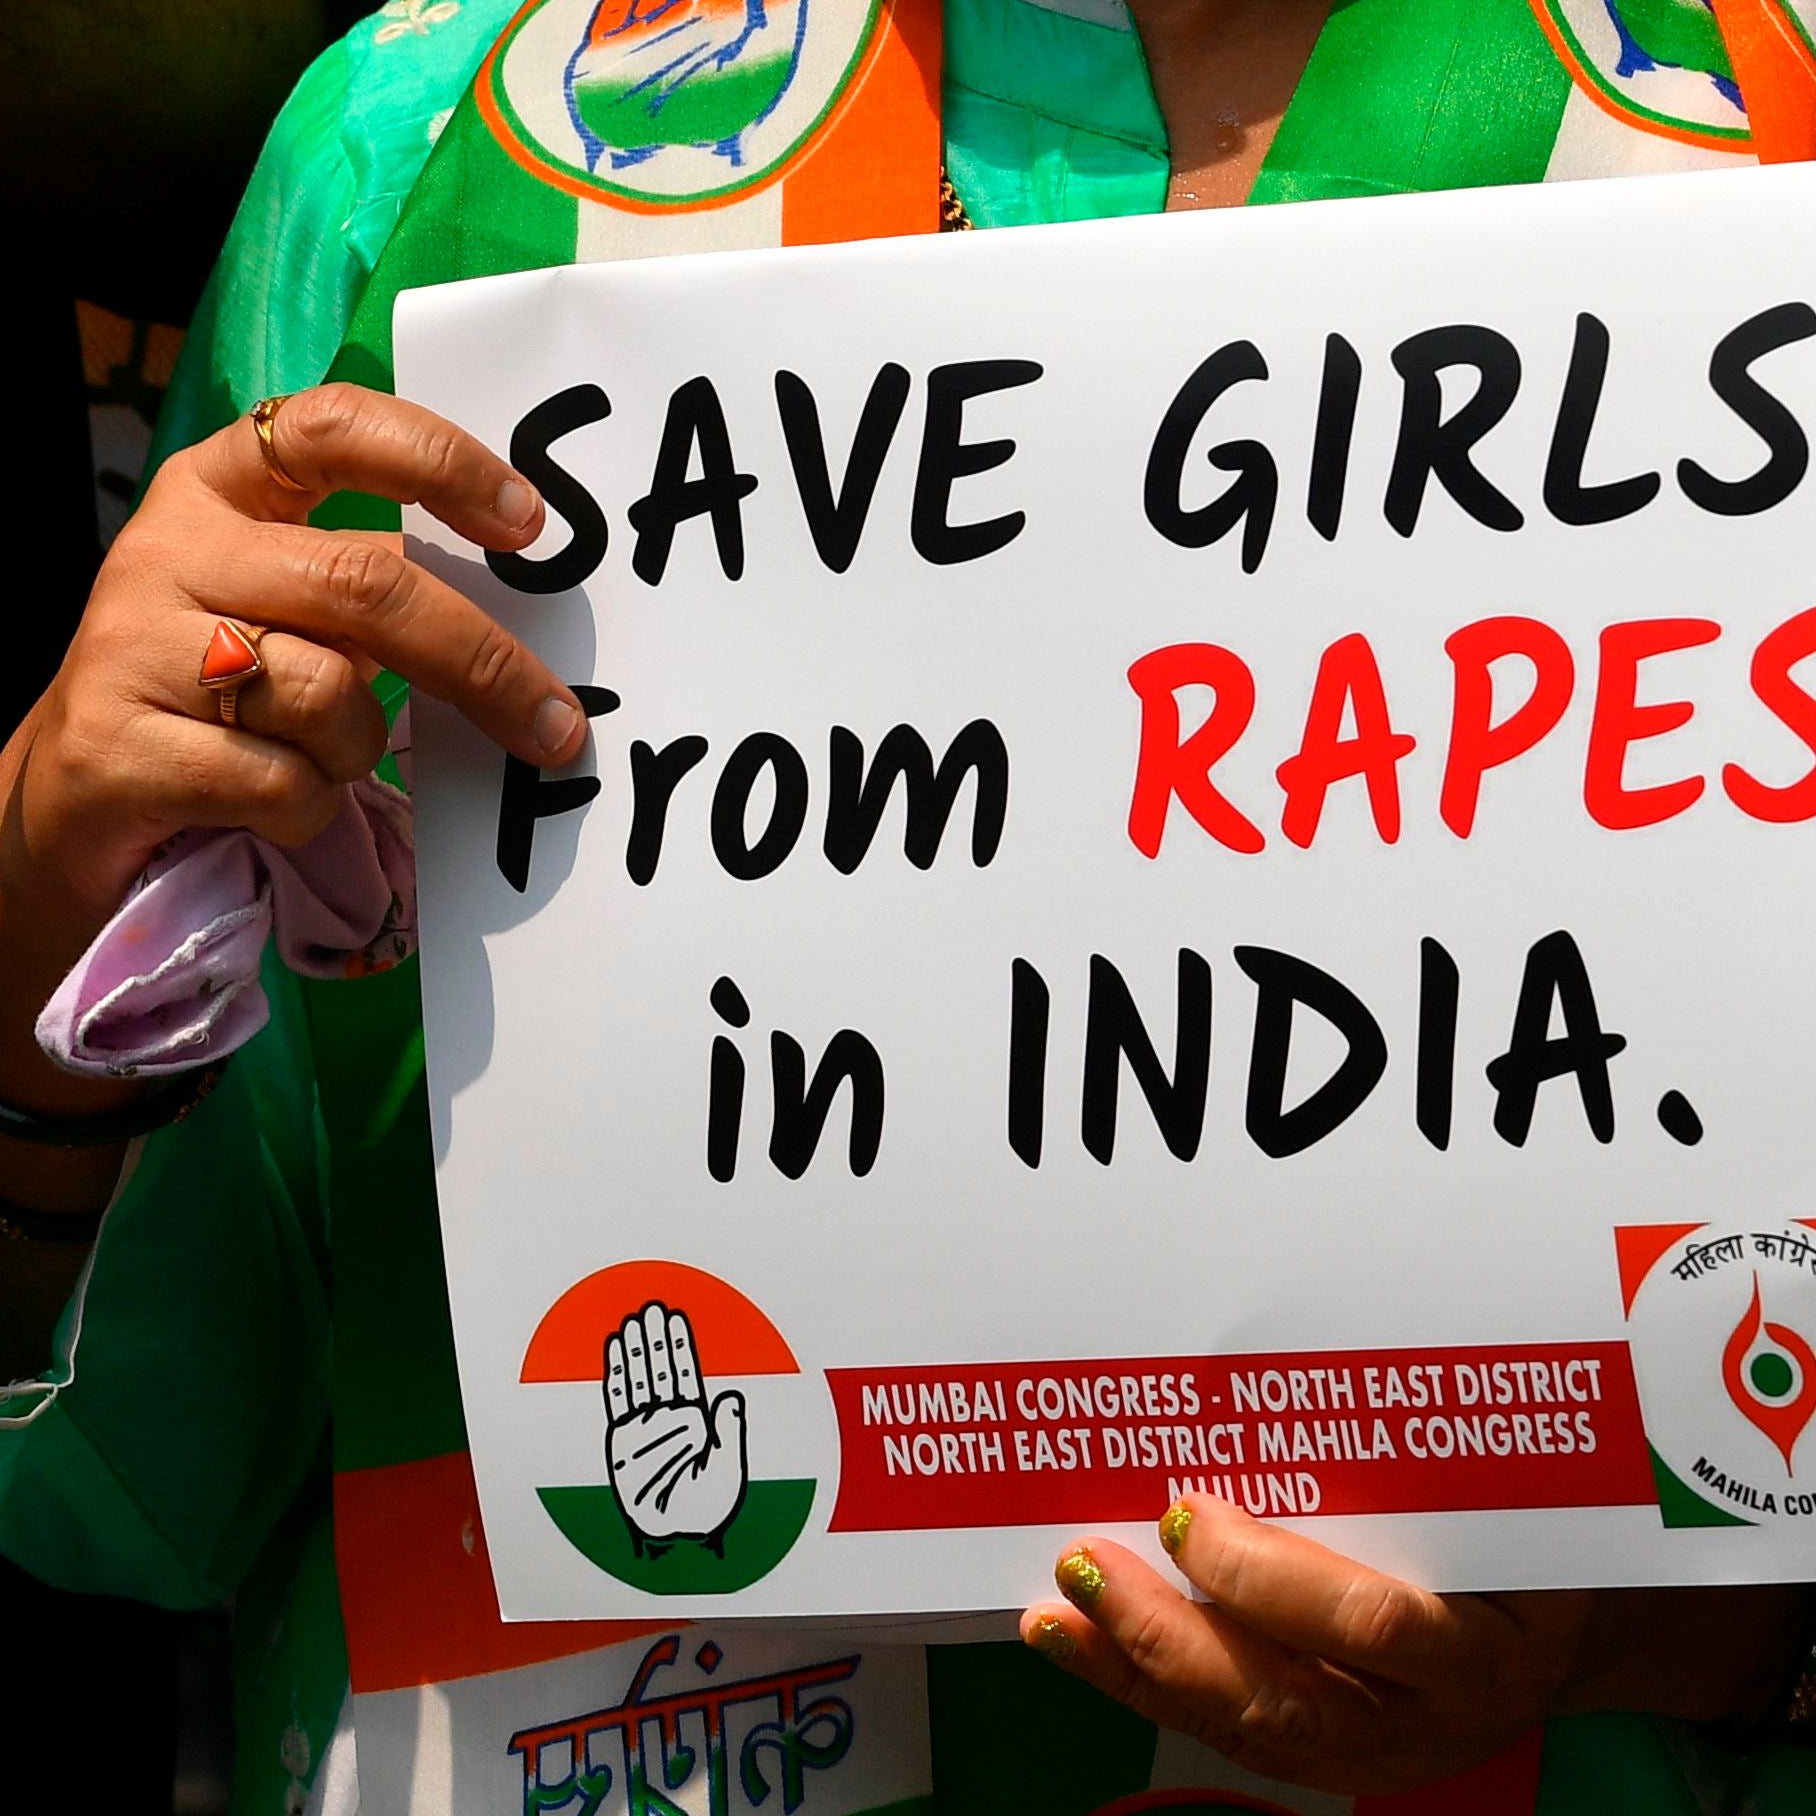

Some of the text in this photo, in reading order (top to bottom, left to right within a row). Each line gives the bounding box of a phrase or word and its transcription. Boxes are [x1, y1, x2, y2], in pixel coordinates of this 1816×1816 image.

[479, 359, 1044, 596] SAVE
[488, 678, 1009, 894] From
[707, 929, 1704, 1183] in INDIA.
[1671, 1234, 1743, 1281] महिला
[862, 1380, 1007, 1426] MUMBAI
[1016, 1373, 1200, 1421] CONGRESS
[1230, 1368, 1355, 1413] NORTH
[1363, 1365, 1443, 1408] EAST
[1454, 1359, 1601, 1405] DISTRICT
[883, 1411, 1596, 1476] NORTH EAST DISTRICT MAHILA CONGRESS
[1691, 1456, 1777, 1515] MAHILA
